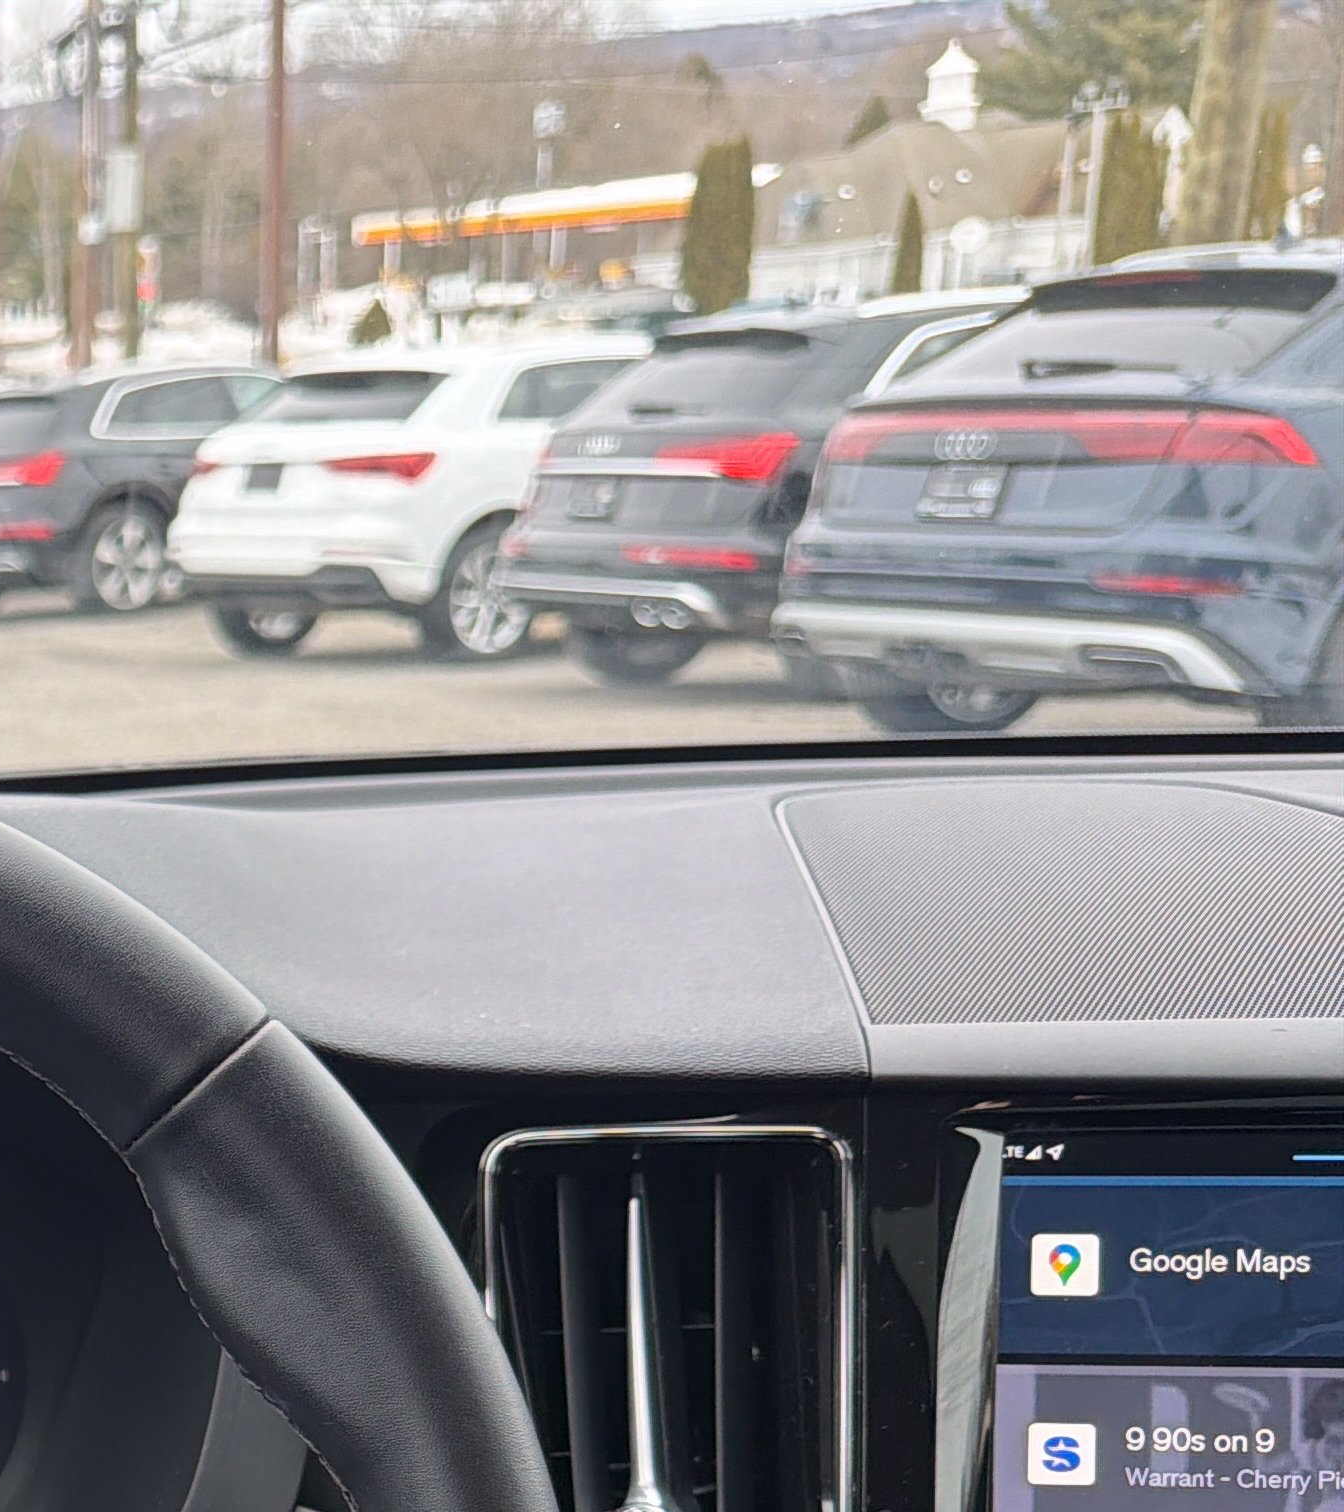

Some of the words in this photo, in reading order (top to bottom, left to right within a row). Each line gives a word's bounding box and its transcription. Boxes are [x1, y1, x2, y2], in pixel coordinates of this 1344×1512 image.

[1001, 1145, 1024, 1159] TE
[1129, 1247, 1229, 1280] Google
[1236, 1249, 1311, 1281] Maps
[1125, 1426, 1146, 1451] 9
[1152, 1427, 1206, 1452] 90s
[1214, 1434, 1248, 1453] on
[1255, 1428, 1275, 1453] 9
[1125, 1466, 1215, 1489] Warrant
[1237, 1468, 1311, 1496] Cherry
